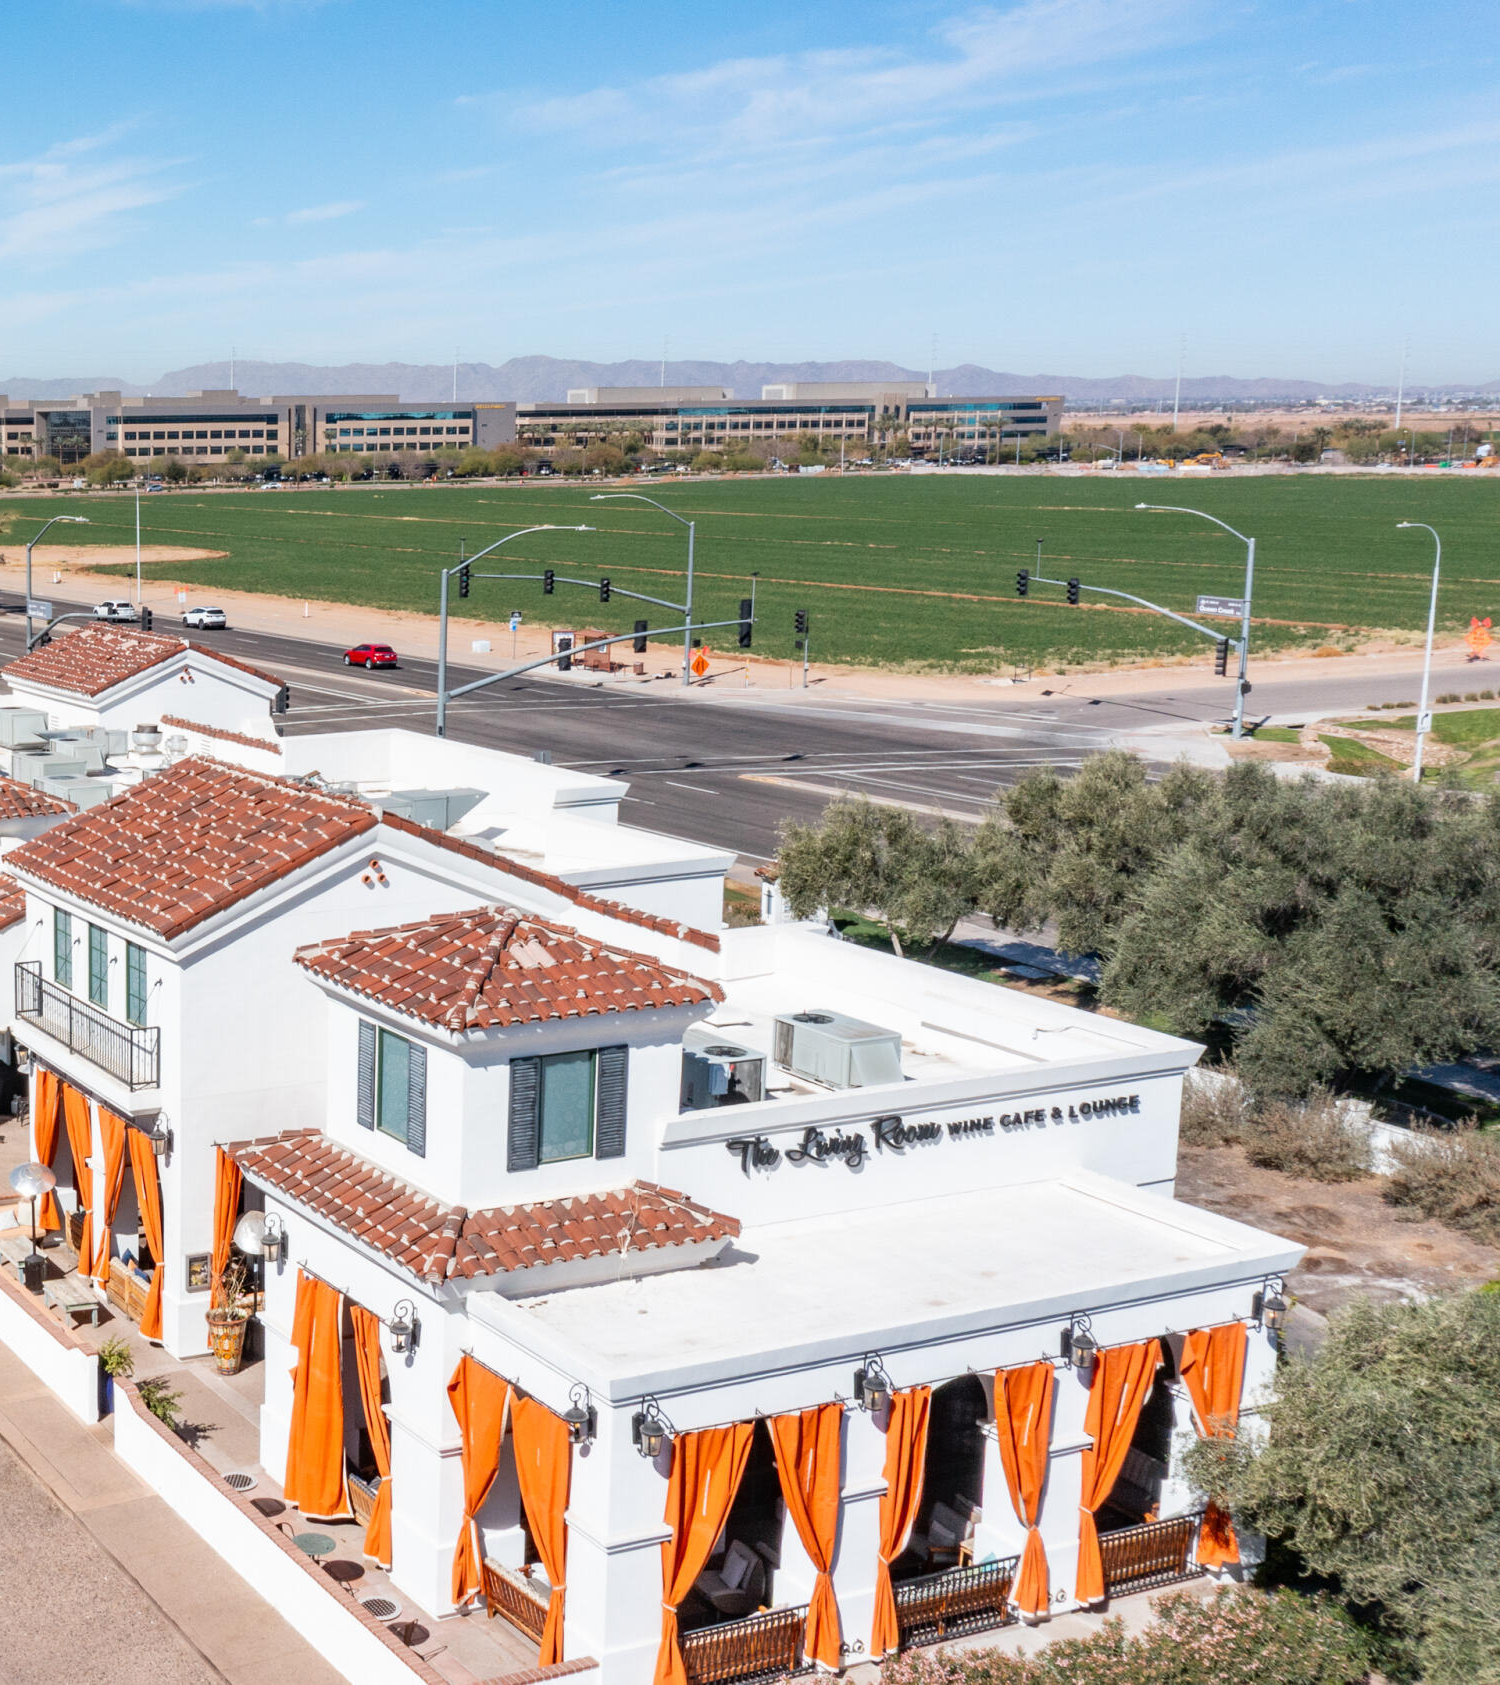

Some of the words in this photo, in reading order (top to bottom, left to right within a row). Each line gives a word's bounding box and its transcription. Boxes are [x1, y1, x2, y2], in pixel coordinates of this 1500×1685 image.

[725, 1136, 780, 1173] The
[784, 1125, 869, 1168] Living
[869, 1115, 941, 1149] Room
[947, 1117, 994, 1136] WINE
[999, 1109, 1046, 1128] CAFE
[1051, 1107, 1063, 1119] &
[1068, 1095, 1140, 1120] LOUNGE
